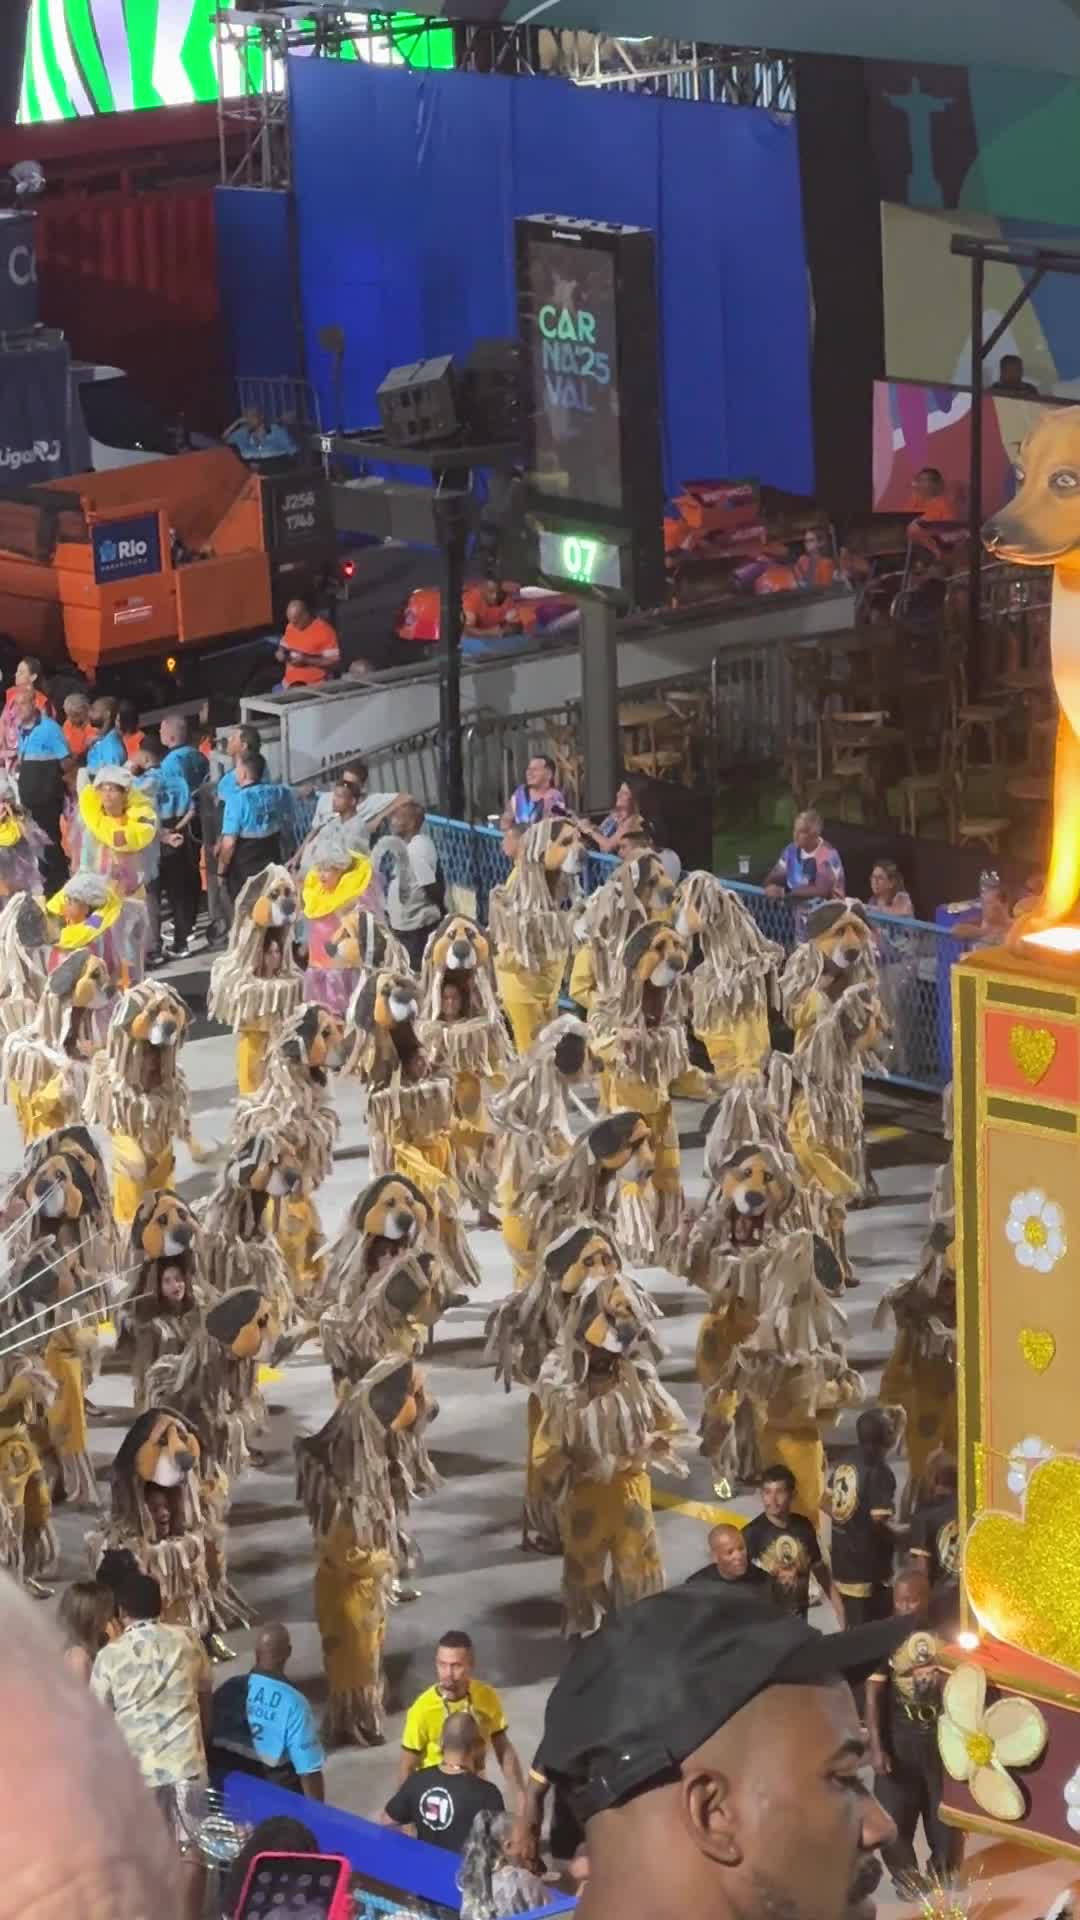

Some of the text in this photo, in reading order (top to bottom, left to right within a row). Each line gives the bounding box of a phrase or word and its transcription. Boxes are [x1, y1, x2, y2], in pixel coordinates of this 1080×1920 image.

[538, 304, 596, 344] CAR
[544, 374, 595, 412] VAL
[118, 539, 148, 559] Rio
[563, 536, 598, 576] 07
